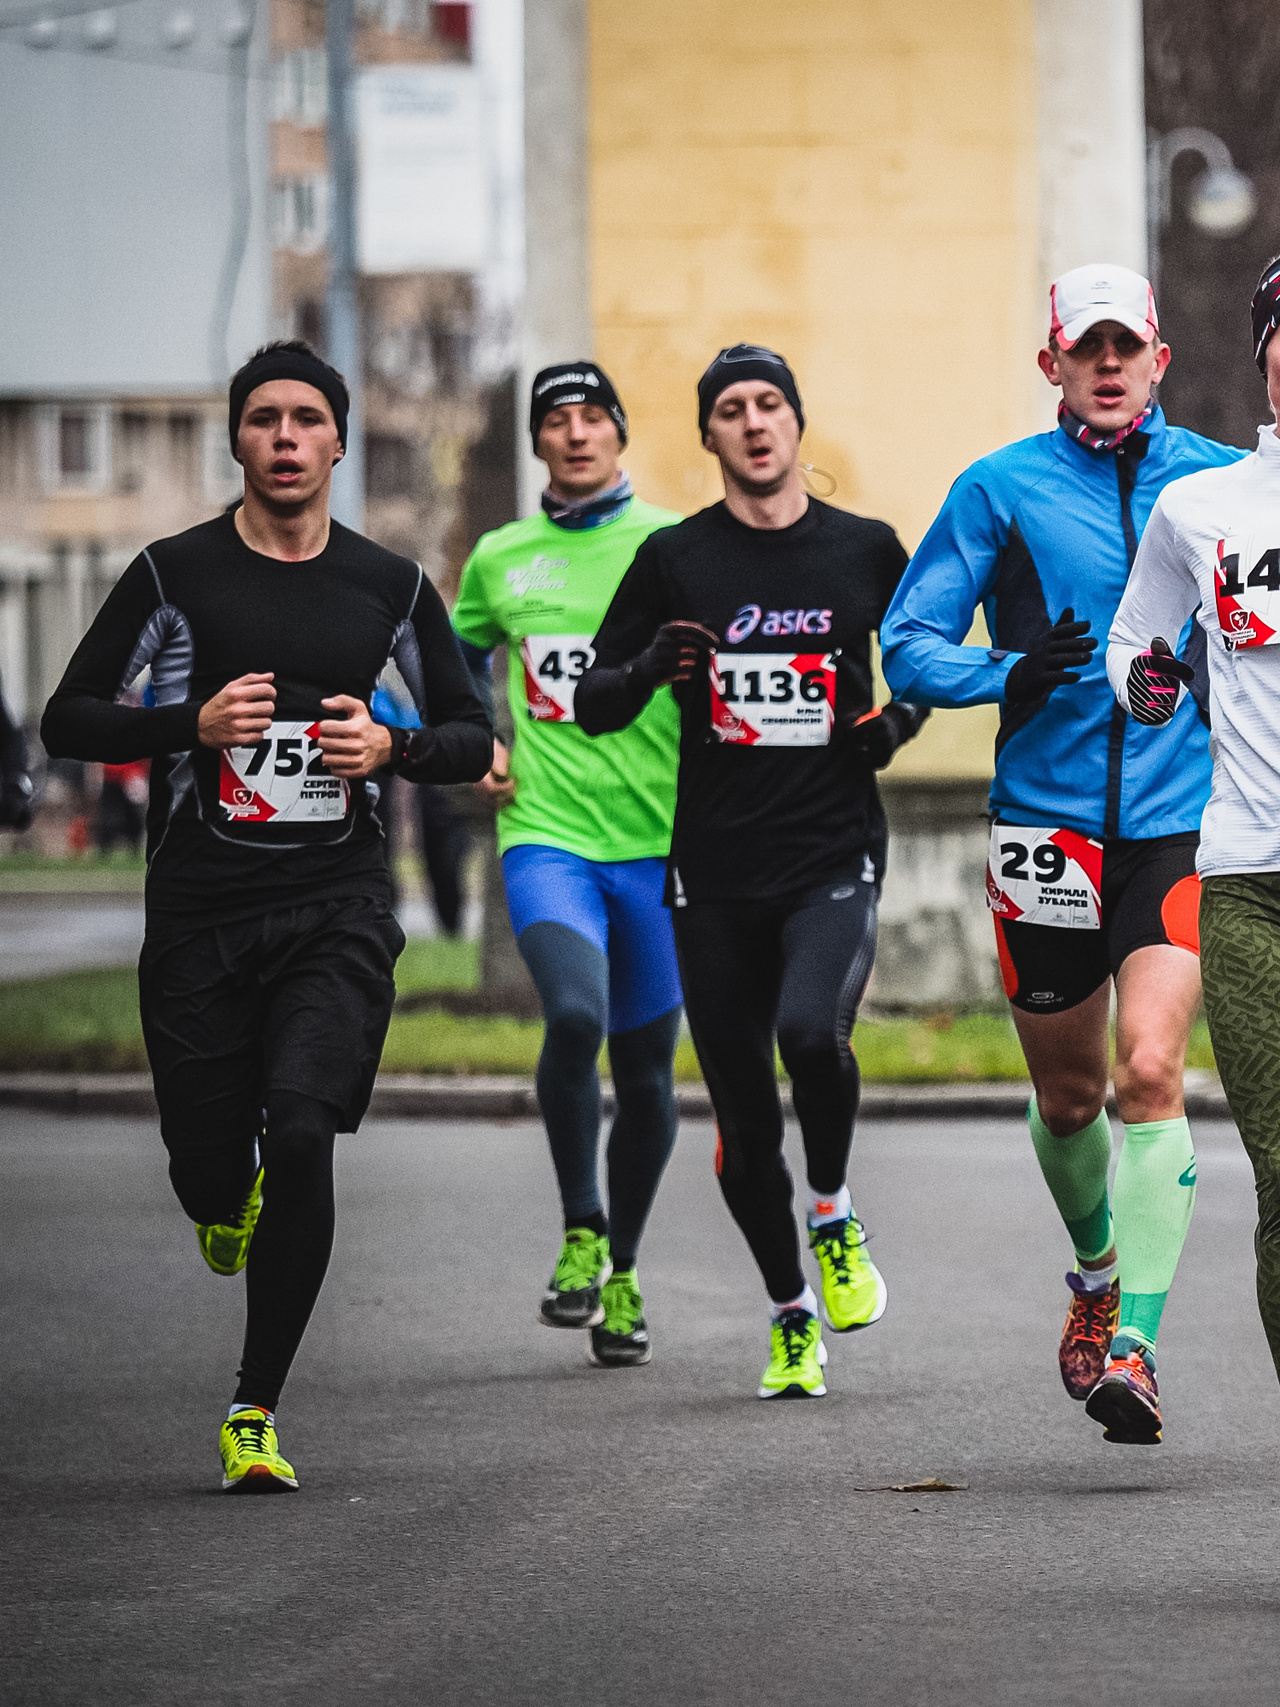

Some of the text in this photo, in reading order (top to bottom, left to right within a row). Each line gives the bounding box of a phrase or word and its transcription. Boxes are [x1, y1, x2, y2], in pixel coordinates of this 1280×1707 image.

[761, 609, 832, 636] asics
[719, 669, 827, 703] 1136
[240, 738, 331, 777] 752
[300, 790, 341, 800] ПЕТРОВ
[1000, 841, 1067, 884] 29
[1037, 896, 1088, 909] ЗУБАРЕВ
[1040, 886, 1088, 898] КИРИЛЛ
